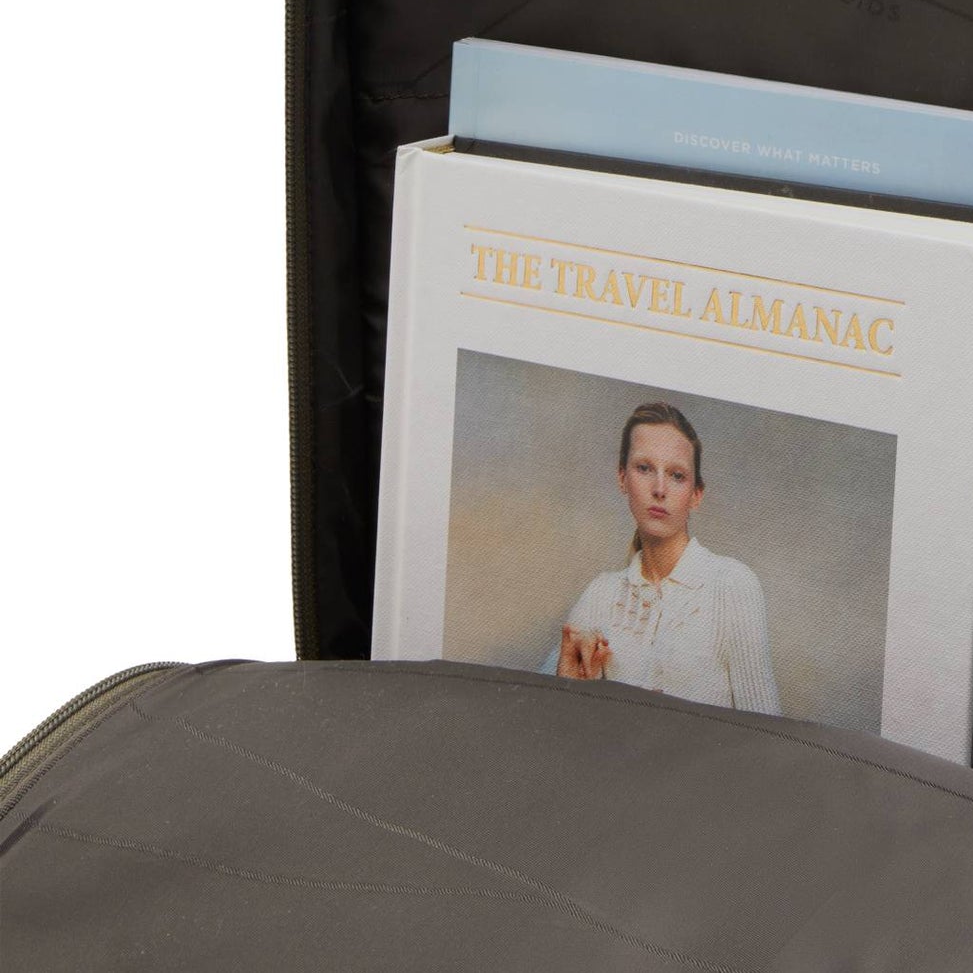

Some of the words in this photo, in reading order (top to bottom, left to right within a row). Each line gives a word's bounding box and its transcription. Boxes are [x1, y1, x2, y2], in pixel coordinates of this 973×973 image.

[674, 131, 751, 154] DISCOVER
[757, 143, 801, 163] WHAT
[808, 152, 881, 175] MATTERS
[471, 243, 542, 291] THE
[550, 257, 692, 319] TRAVEL
[699, 287, 895, 356] ALMANAC
